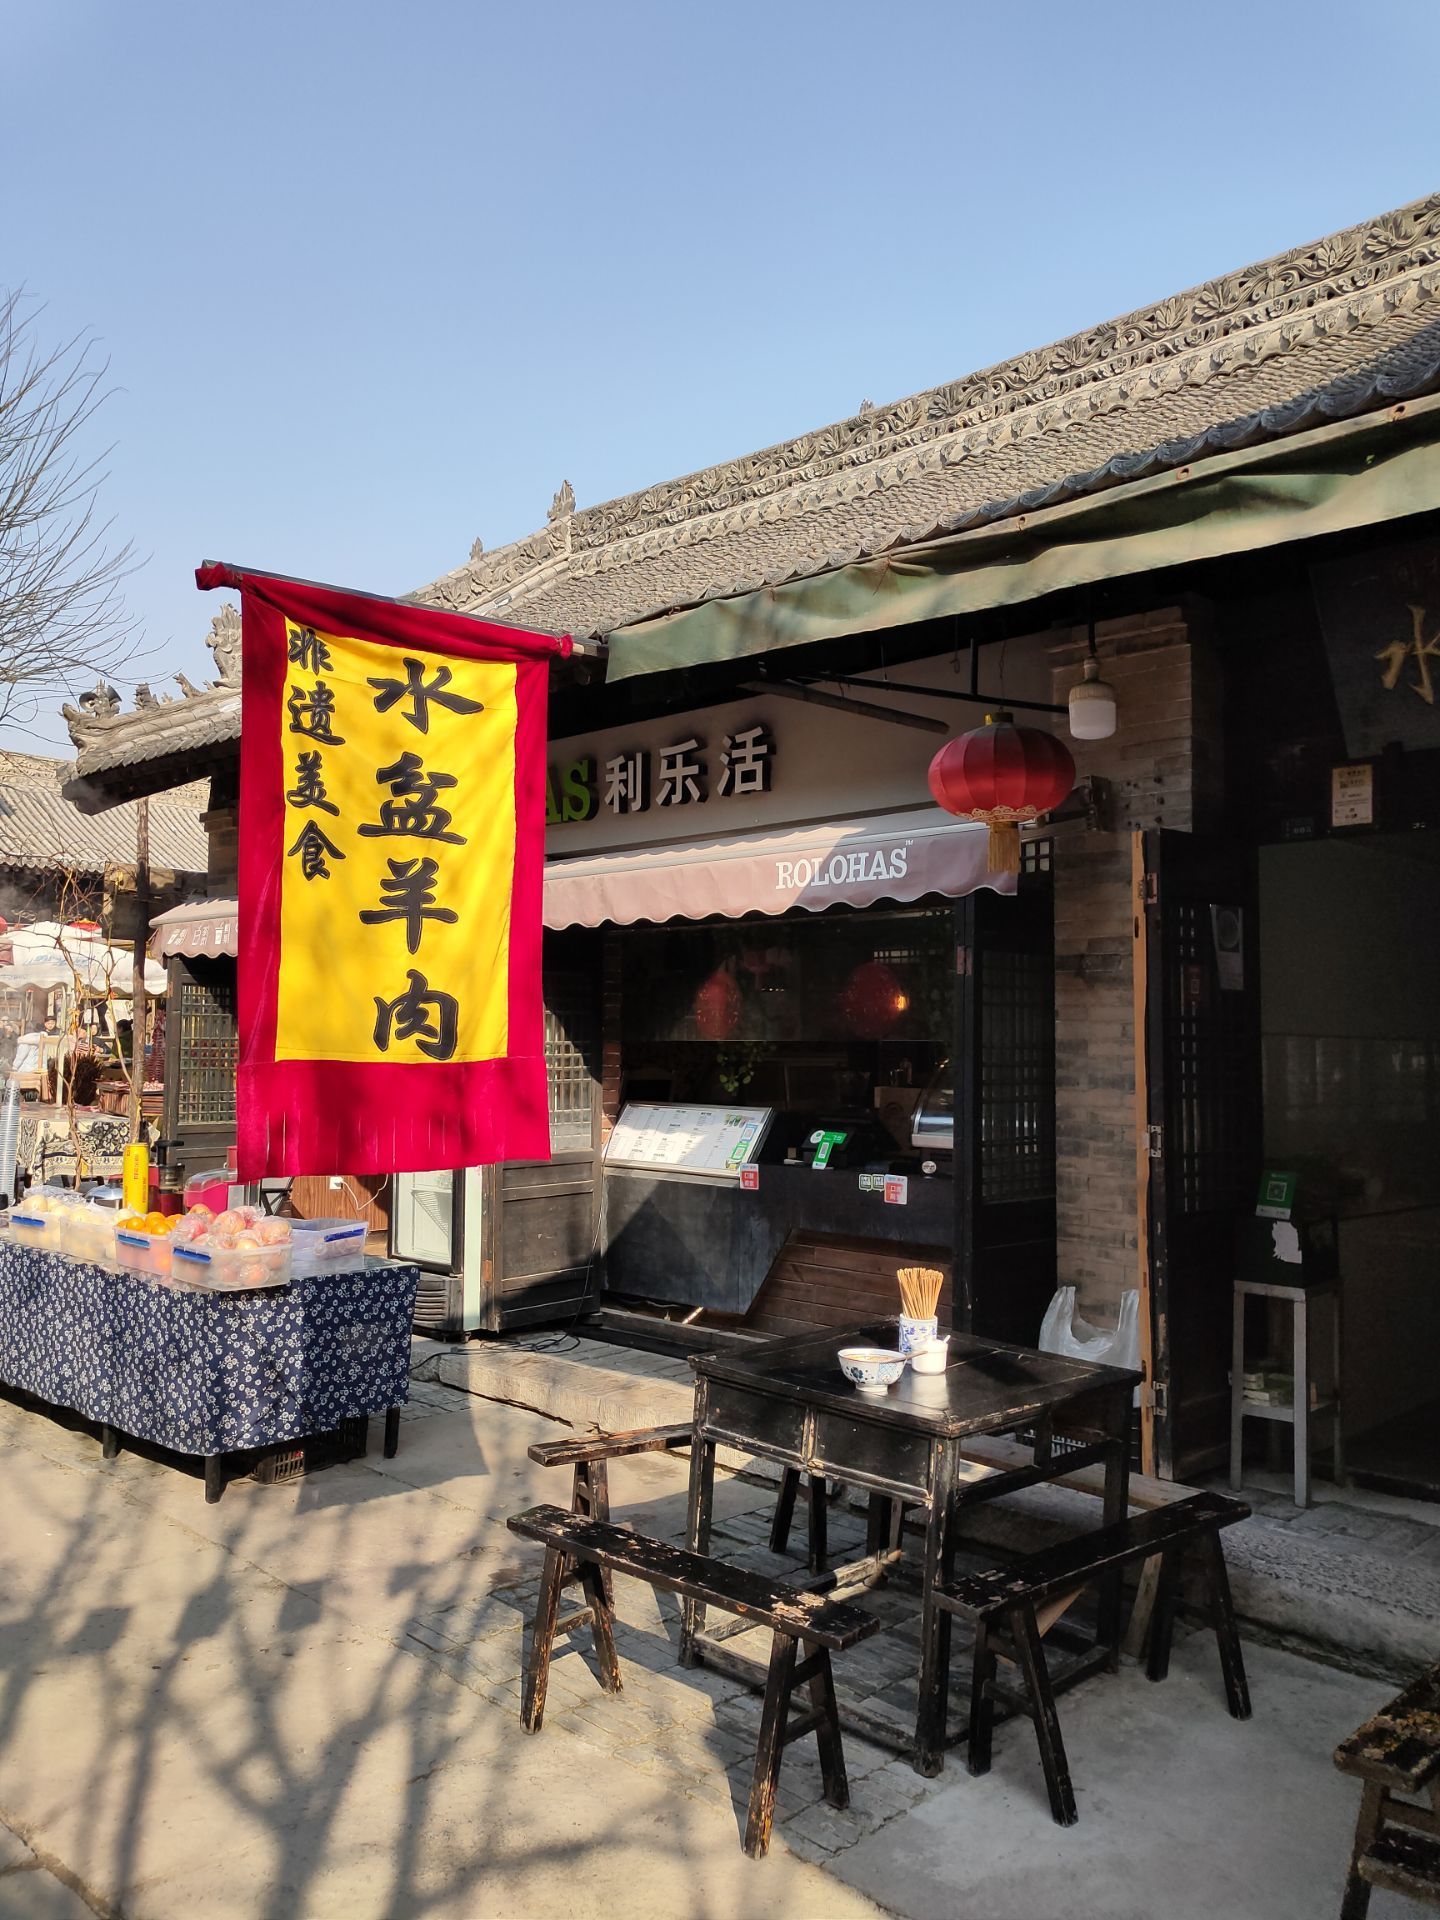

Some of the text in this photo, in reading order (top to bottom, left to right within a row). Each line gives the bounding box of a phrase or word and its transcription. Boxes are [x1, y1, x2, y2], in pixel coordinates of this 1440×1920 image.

[286, 626, 346, 881] 非遗美食
[604, 725, 769, 814] 利乐活
[356, 657, 485, 1061] 水盆羊肉
[775, 847, 908, 891] ROLOHAS
